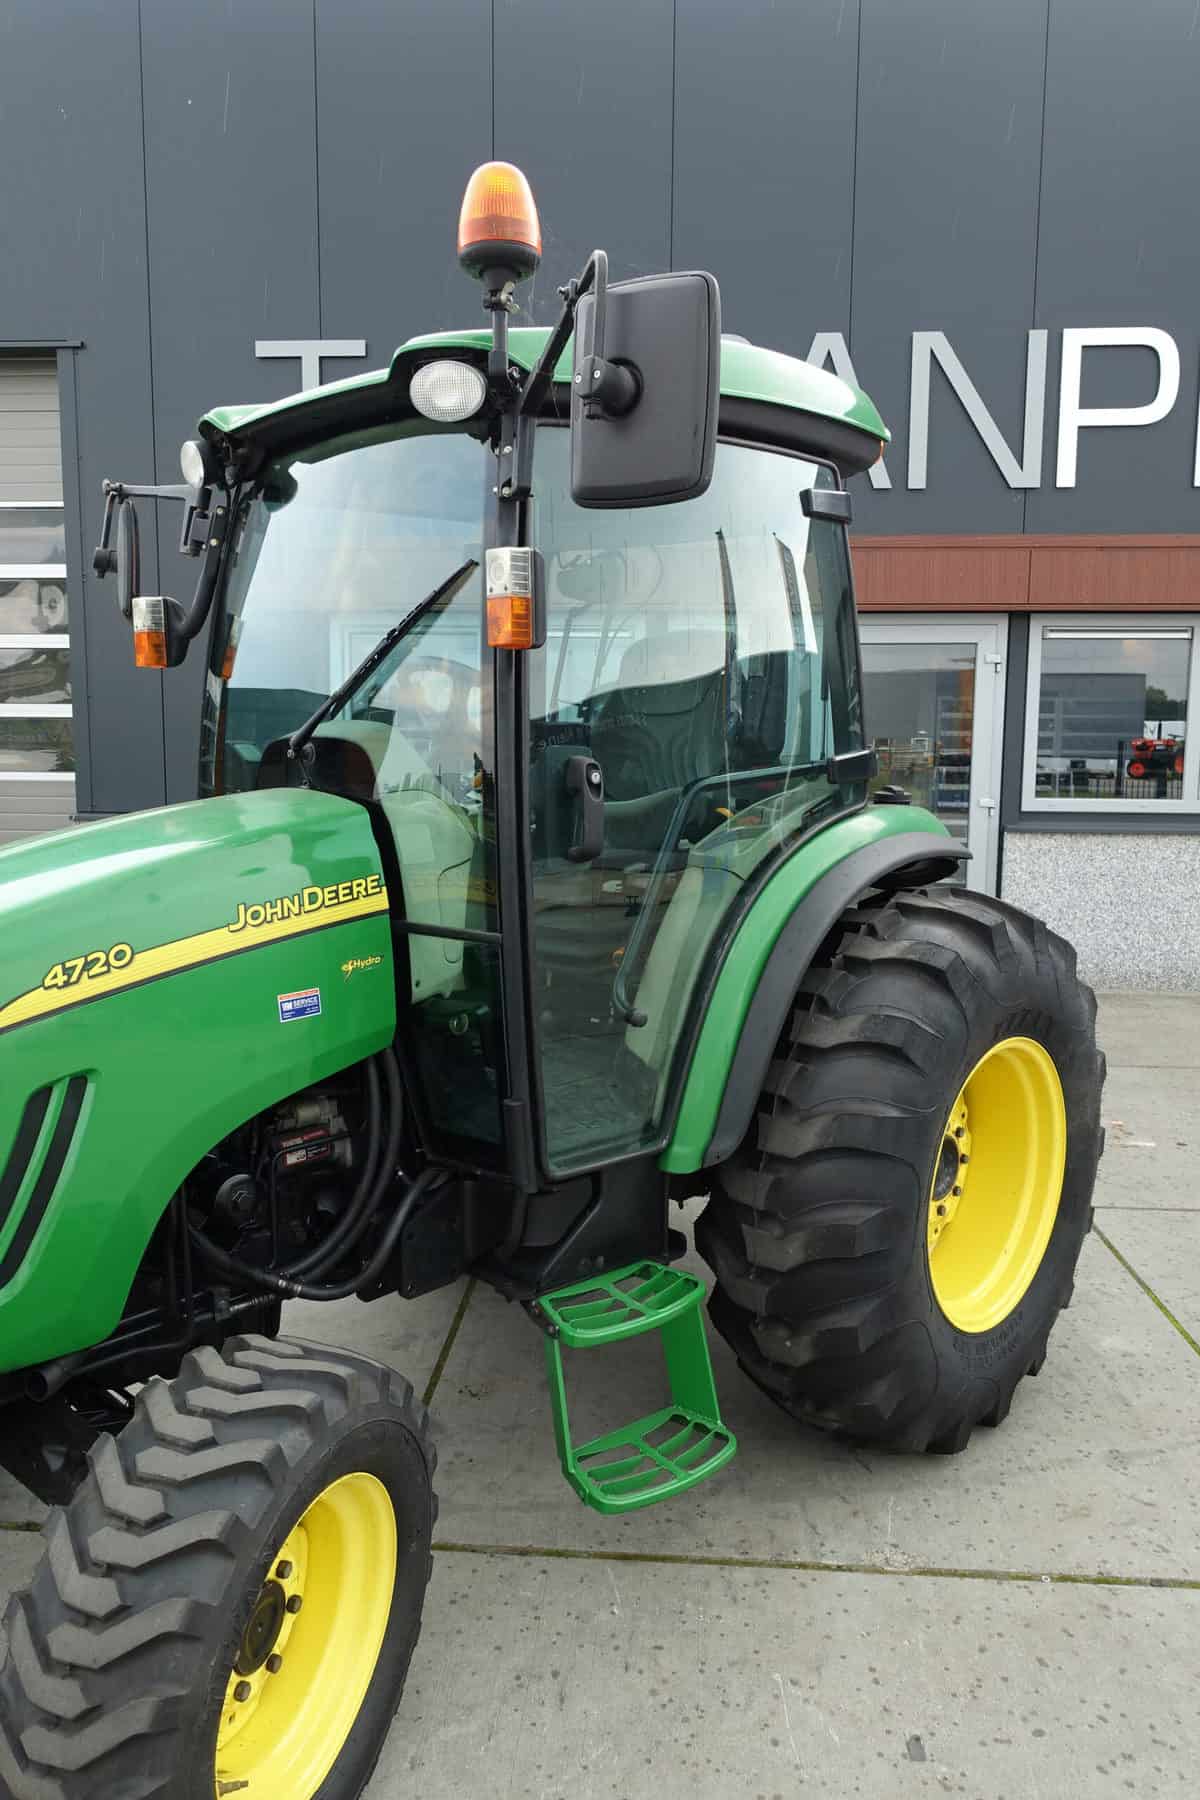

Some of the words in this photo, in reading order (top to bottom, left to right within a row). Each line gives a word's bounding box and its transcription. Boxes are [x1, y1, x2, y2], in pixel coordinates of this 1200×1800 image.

[228, 893, 301, 932] JOHN
[303, 874, 381, 913] DEERE
[43, 942, 134, 990] 4720
